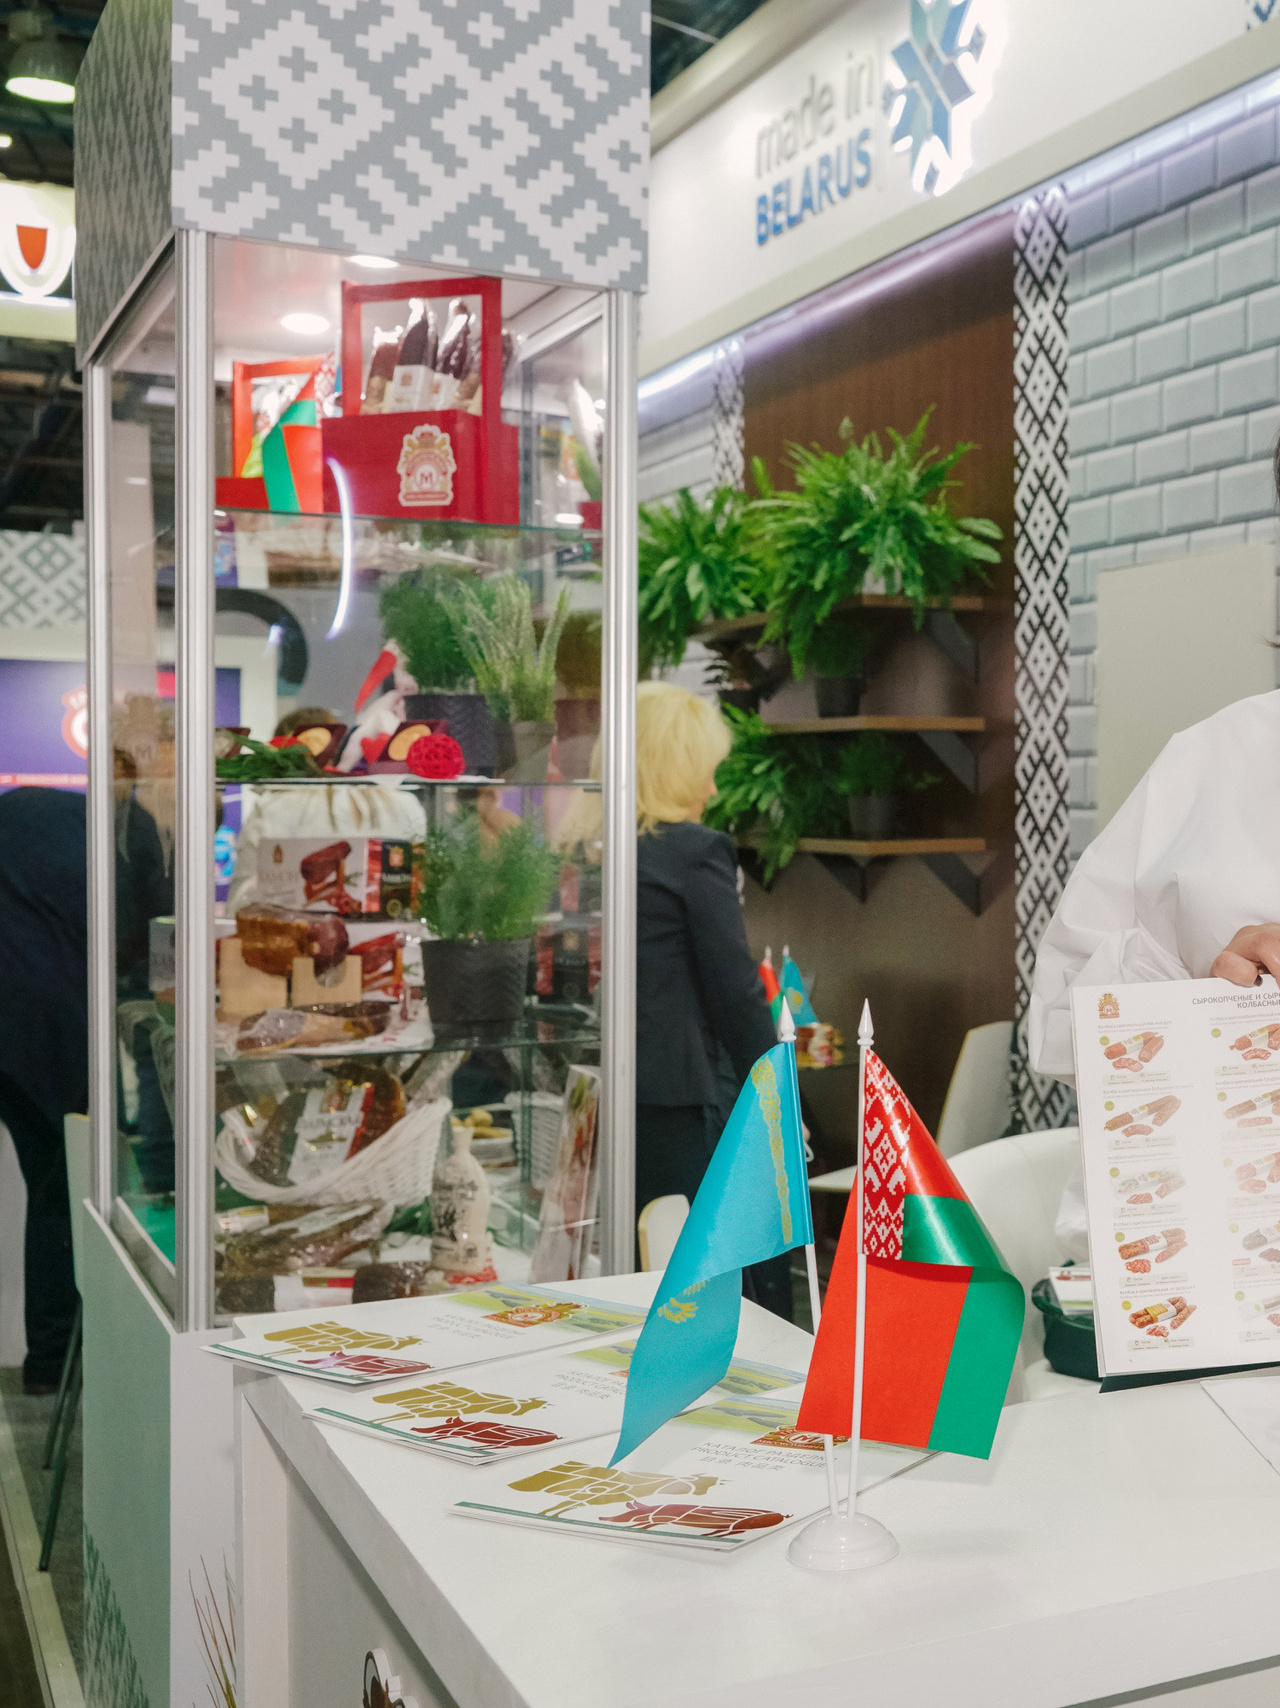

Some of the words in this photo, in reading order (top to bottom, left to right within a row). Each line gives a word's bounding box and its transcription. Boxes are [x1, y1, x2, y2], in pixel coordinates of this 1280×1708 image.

[755, 73, 835, 179] made
[845, 52, 874, 121] in
[757, 127, 871, 246] BELARUS
[1192, 994, 1253, 1005] СЫРОКОПЧЕНЫЕ
